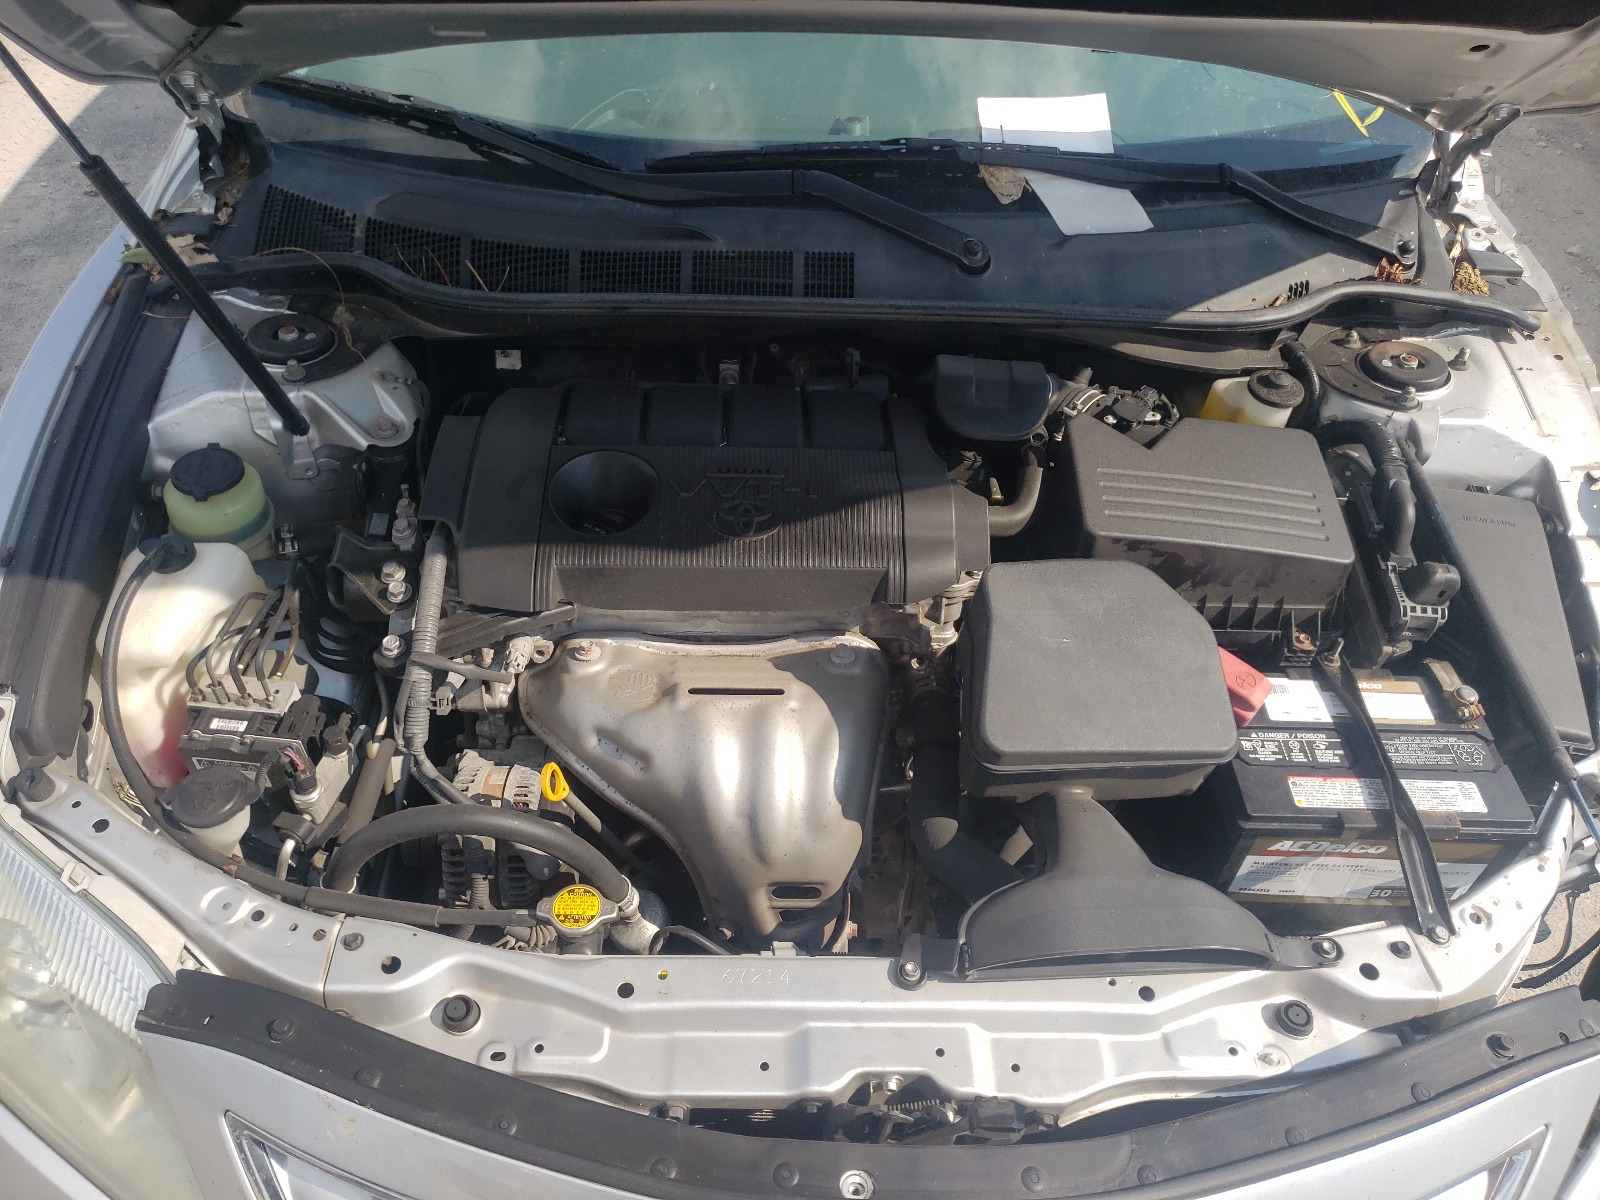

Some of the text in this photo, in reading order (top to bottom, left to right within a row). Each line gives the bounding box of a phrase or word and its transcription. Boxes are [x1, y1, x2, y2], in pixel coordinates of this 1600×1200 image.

[1357, 682, 1383, 690] elco
[1267, 840, 1388, 854] ACDelco
[1369, 889, 1393, 898] 30
[722, 967, 790, 985] 67214
